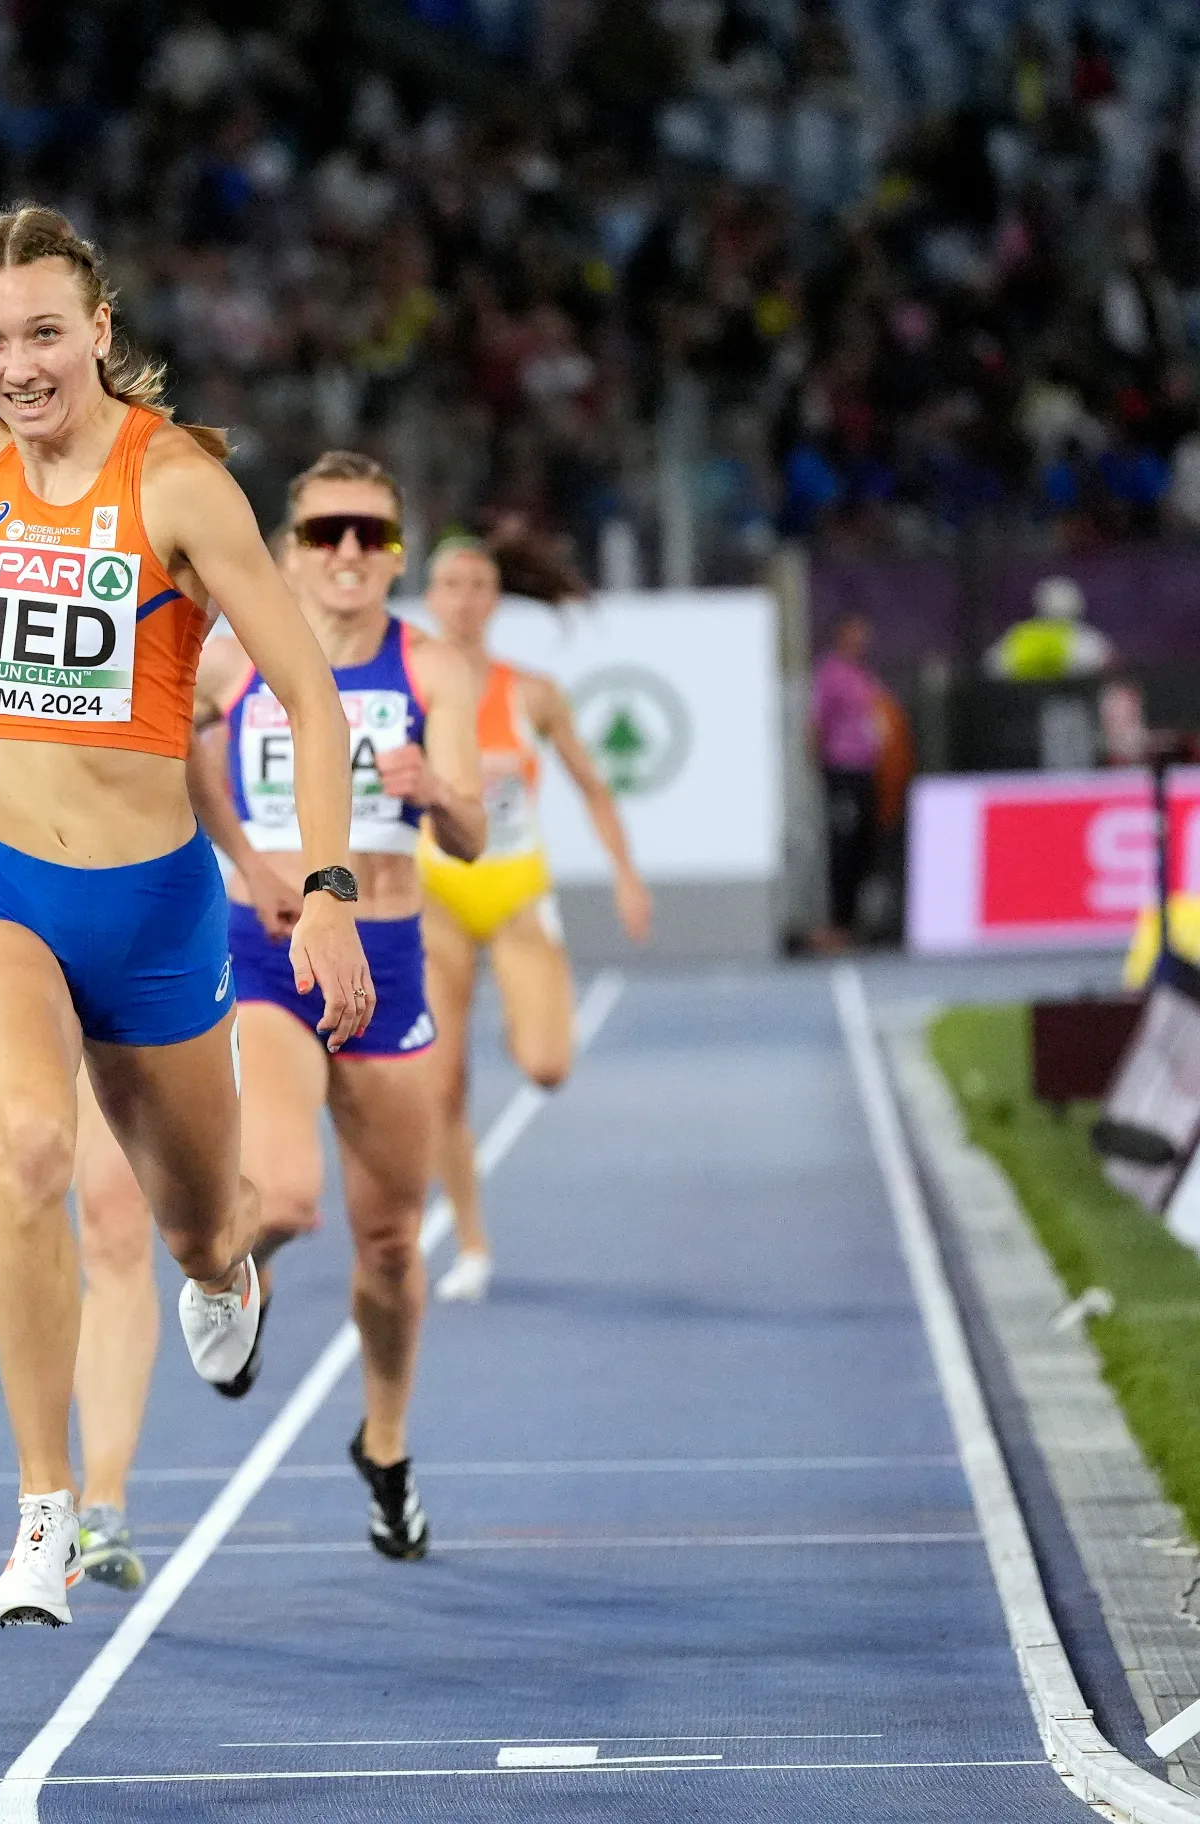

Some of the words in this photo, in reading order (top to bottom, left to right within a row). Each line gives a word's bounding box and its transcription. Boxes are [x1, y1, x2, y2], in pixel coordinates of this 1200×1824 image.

[26, 524, 81, 536] NEDERLANDSE
[23, 533, 61, 545] LOTERIJ
[40, 693, 103, 715] 2024
[261, 735, 383, 782] FA
